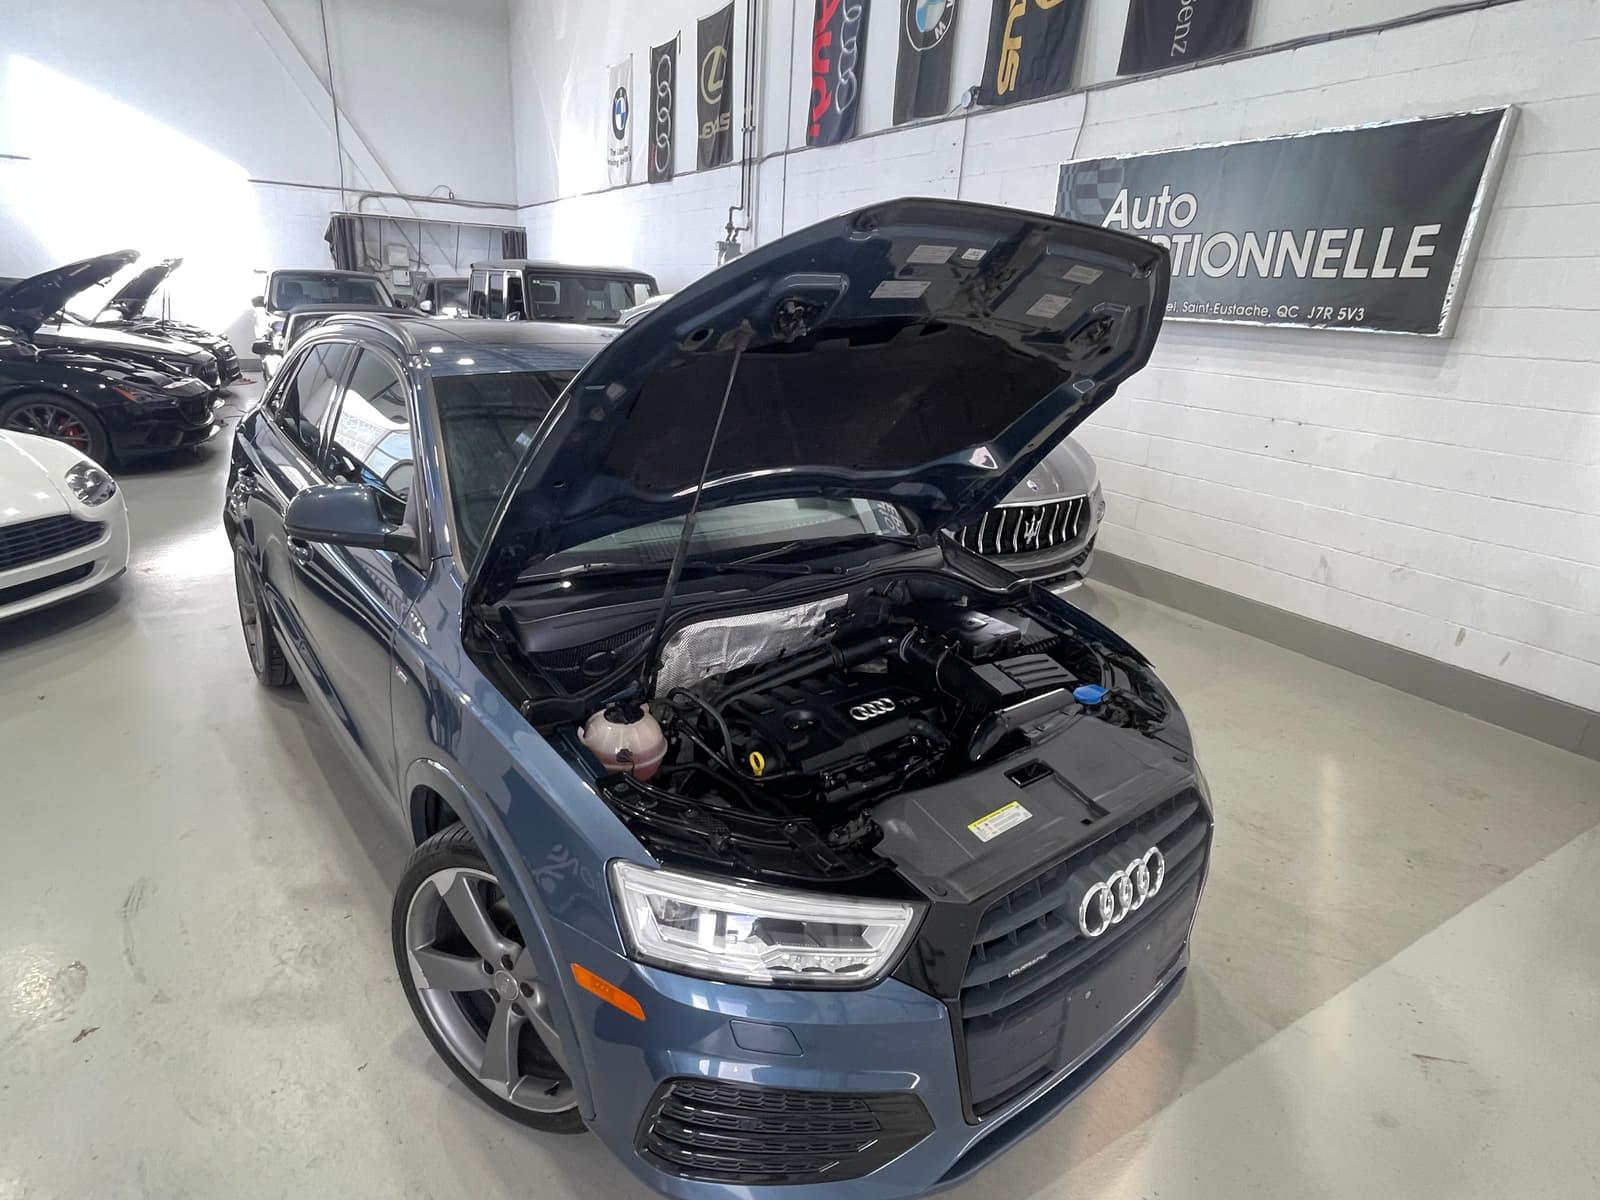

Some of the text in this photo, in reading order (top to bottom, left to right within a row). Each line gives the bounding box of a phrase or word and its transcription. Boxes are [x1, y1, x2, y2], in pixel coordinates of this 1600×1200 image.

[997, 0, 1027, 96] US
[1170, 0, 1195, 57] enz
[1101, 185, 1198, 229] Auto
[1276, 305, 1299, 318] QC
[1307, 306, 1334, 320] J7R
[1337, 307, 1365, 321] 5V3
